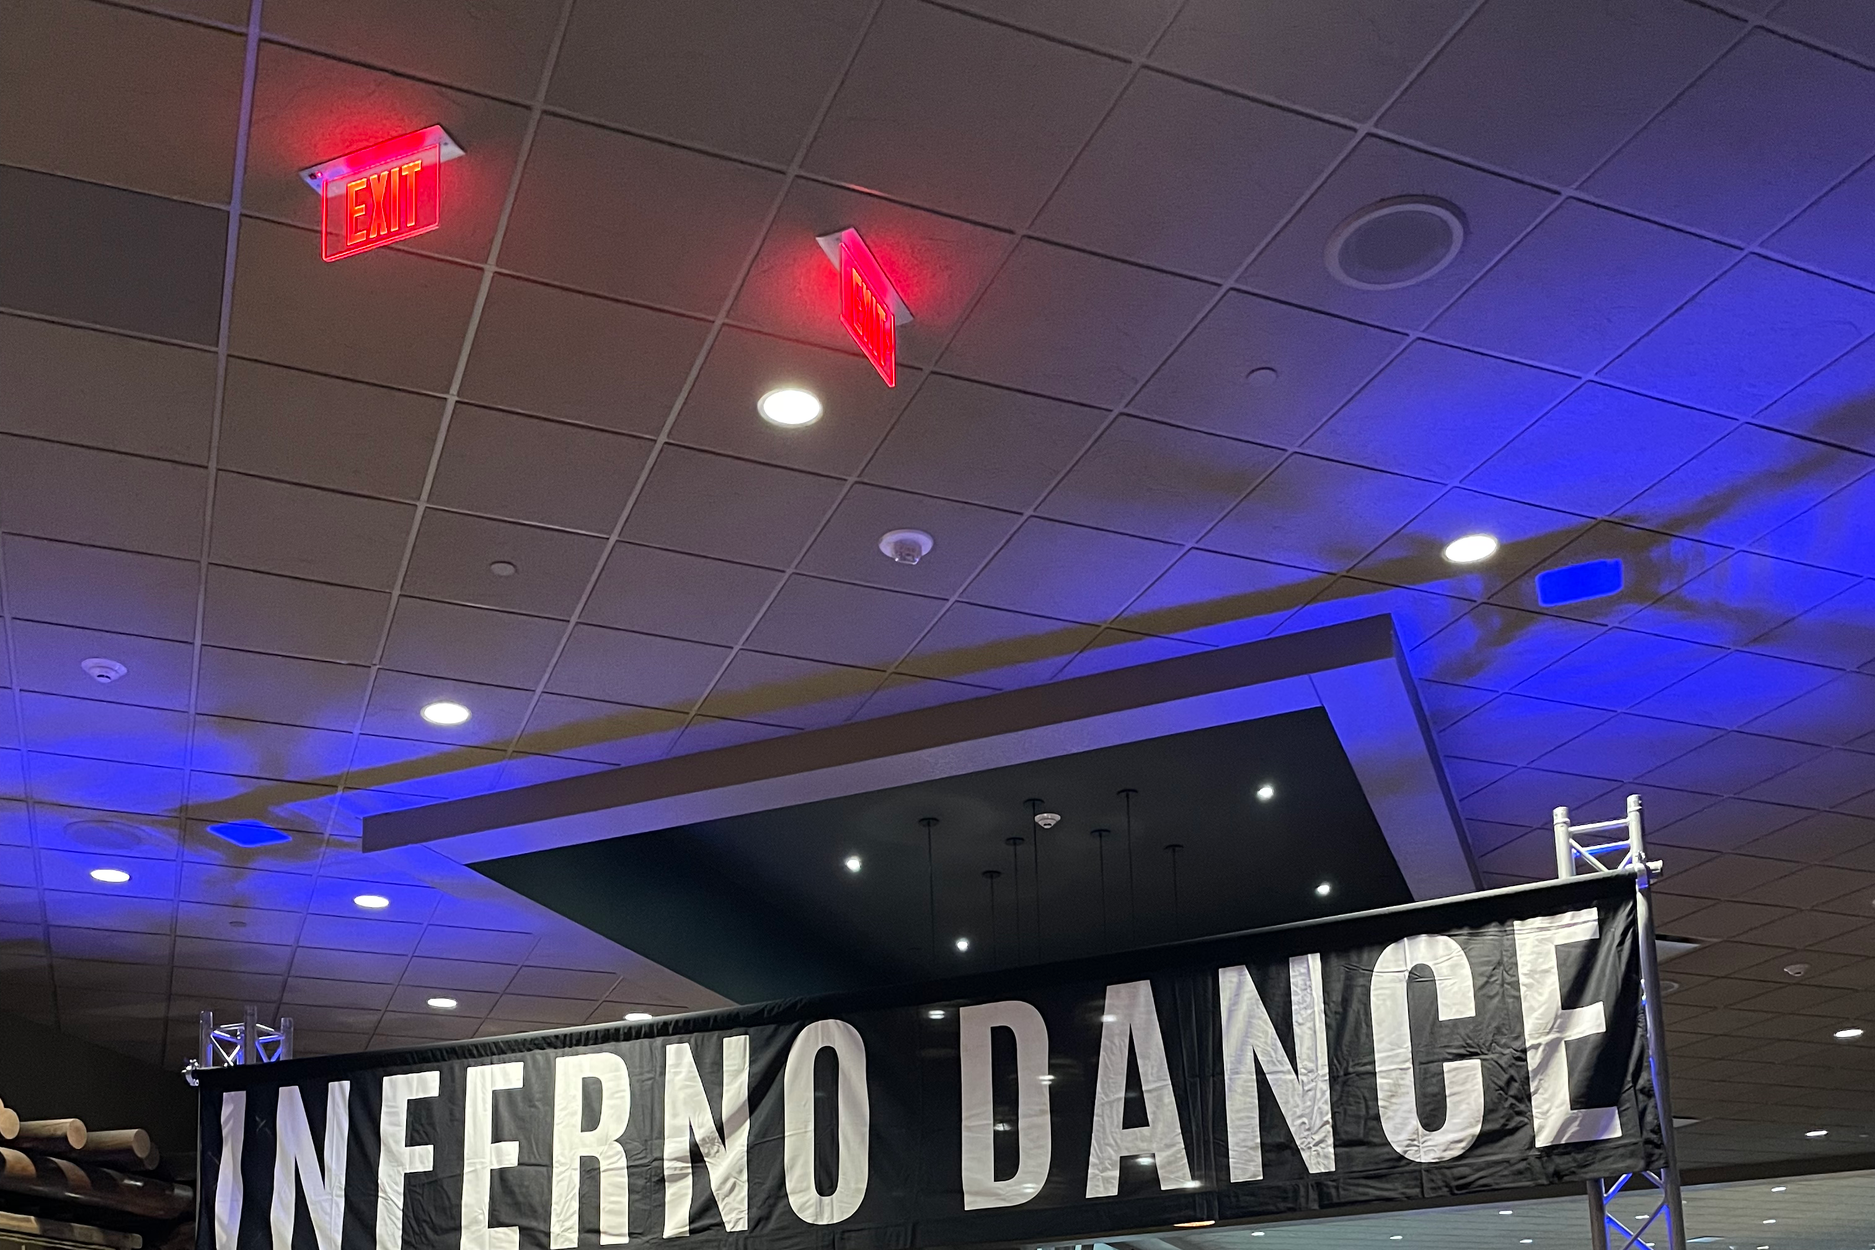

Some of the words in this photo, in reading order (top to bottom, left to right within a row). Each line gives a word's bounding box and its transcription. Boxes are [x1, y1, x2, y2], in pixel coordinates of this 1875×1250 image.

[346, 160, 422, 246] EXIT
[851, 267, 887, 367] EXIT
[959, 906, 1623, 1211] DANCE
